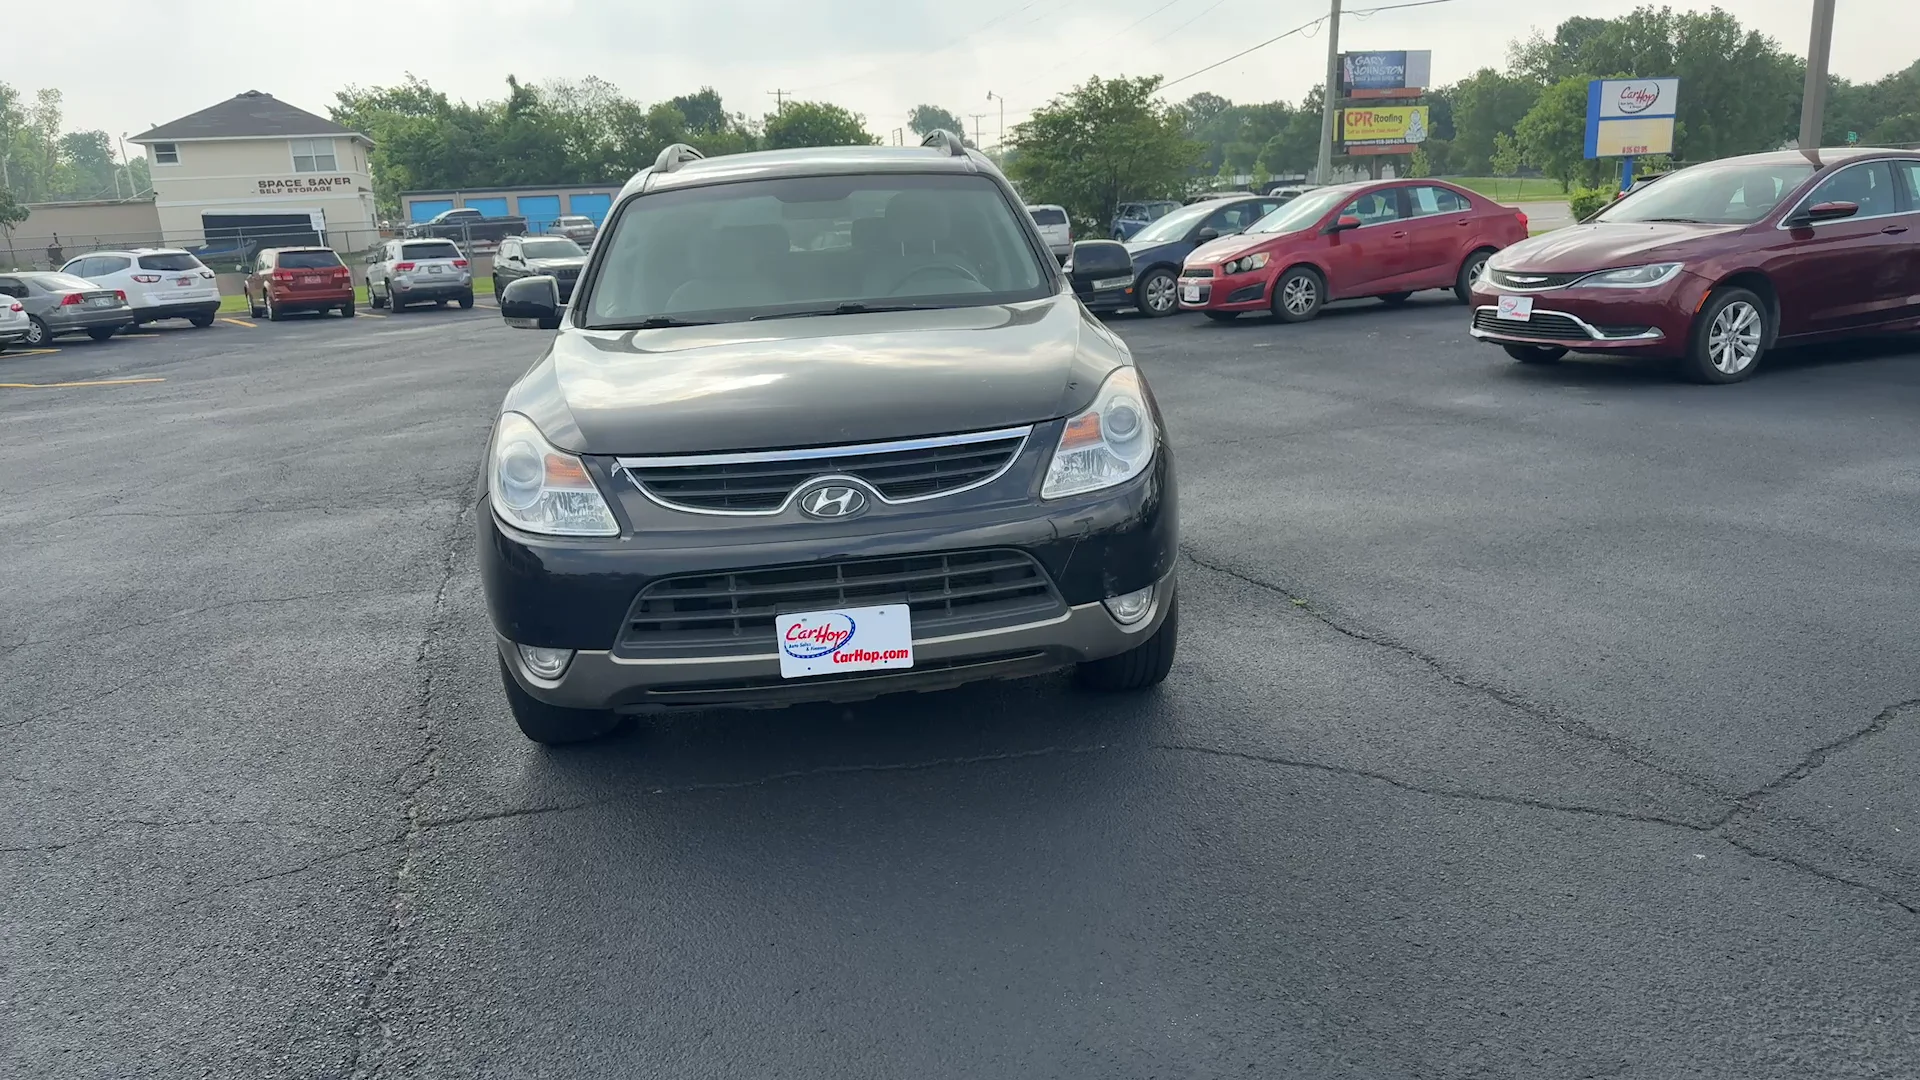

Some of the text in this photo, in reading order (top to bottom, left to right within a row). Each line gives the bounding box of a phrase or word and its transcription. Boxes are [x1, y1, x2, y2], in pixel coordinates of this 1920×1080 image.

[1355, 56, 1386, 66] GARY
[1354, 65, 1404, 76] JOHNSTON
[1620, 86, 1656, 106] CarHop
[1346, 111, 1403, 127] CPR Roofing
[258, 177, 351, 188] SPACE SAVER
[287, 186, 332, 194] STORAGE
[786, 623, 848, 649] CarHop
[833, 649, 909, 664] CarHop.com
